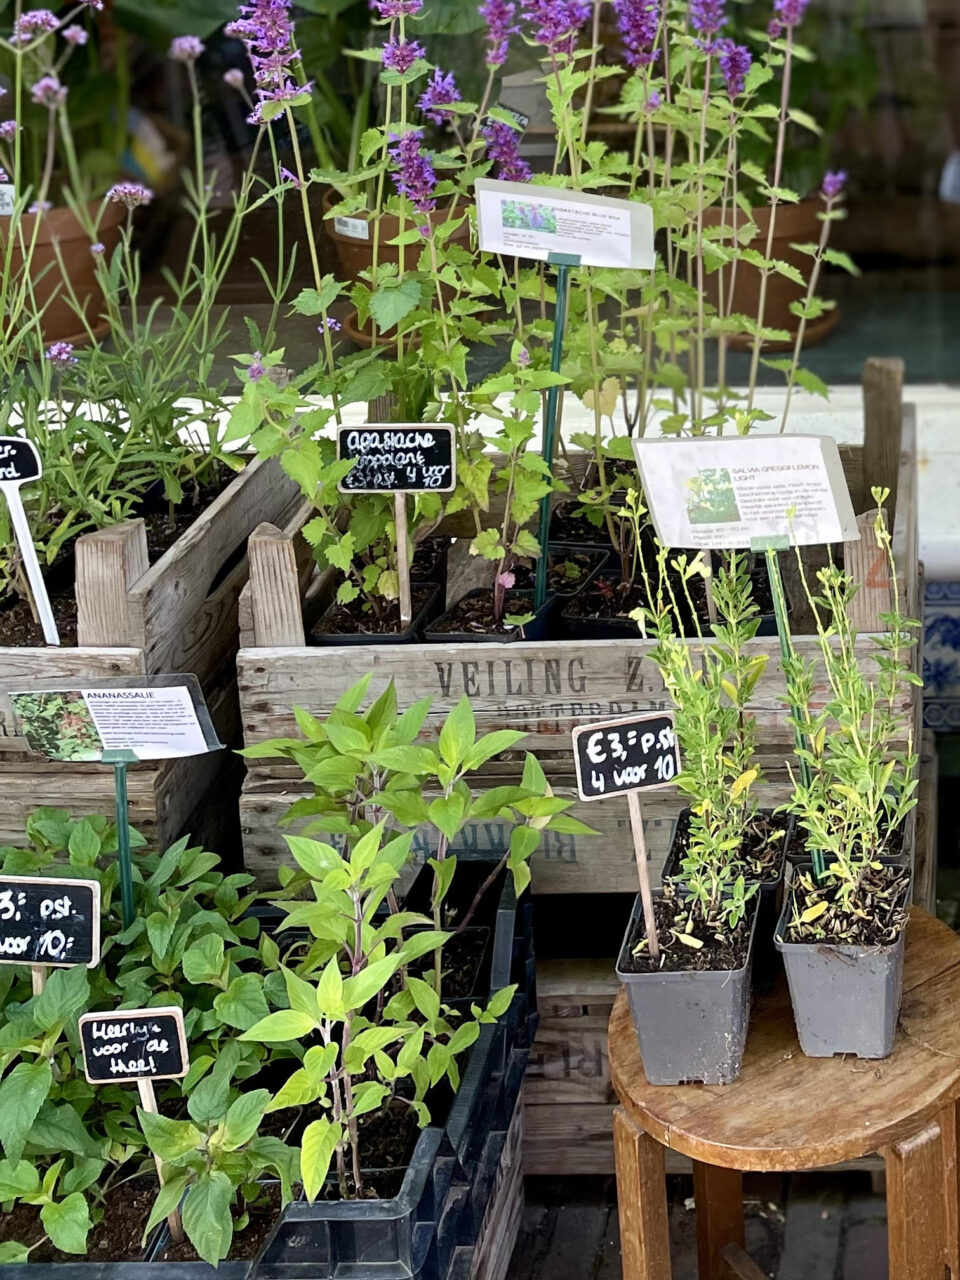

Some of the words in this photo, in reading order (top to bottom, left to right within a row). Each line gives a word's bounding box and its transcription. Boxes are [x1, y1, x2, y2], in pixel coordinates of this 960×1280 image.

[435, 656, 586, 698] VEILING
[87, 691, 155, 700] ANANASSALIE
[591, 770, 605, 793] 4
[613, 764, 648, 786] voor
[653, 753, 675, 781] 10
[92, 1042, 129, 1057] voor
